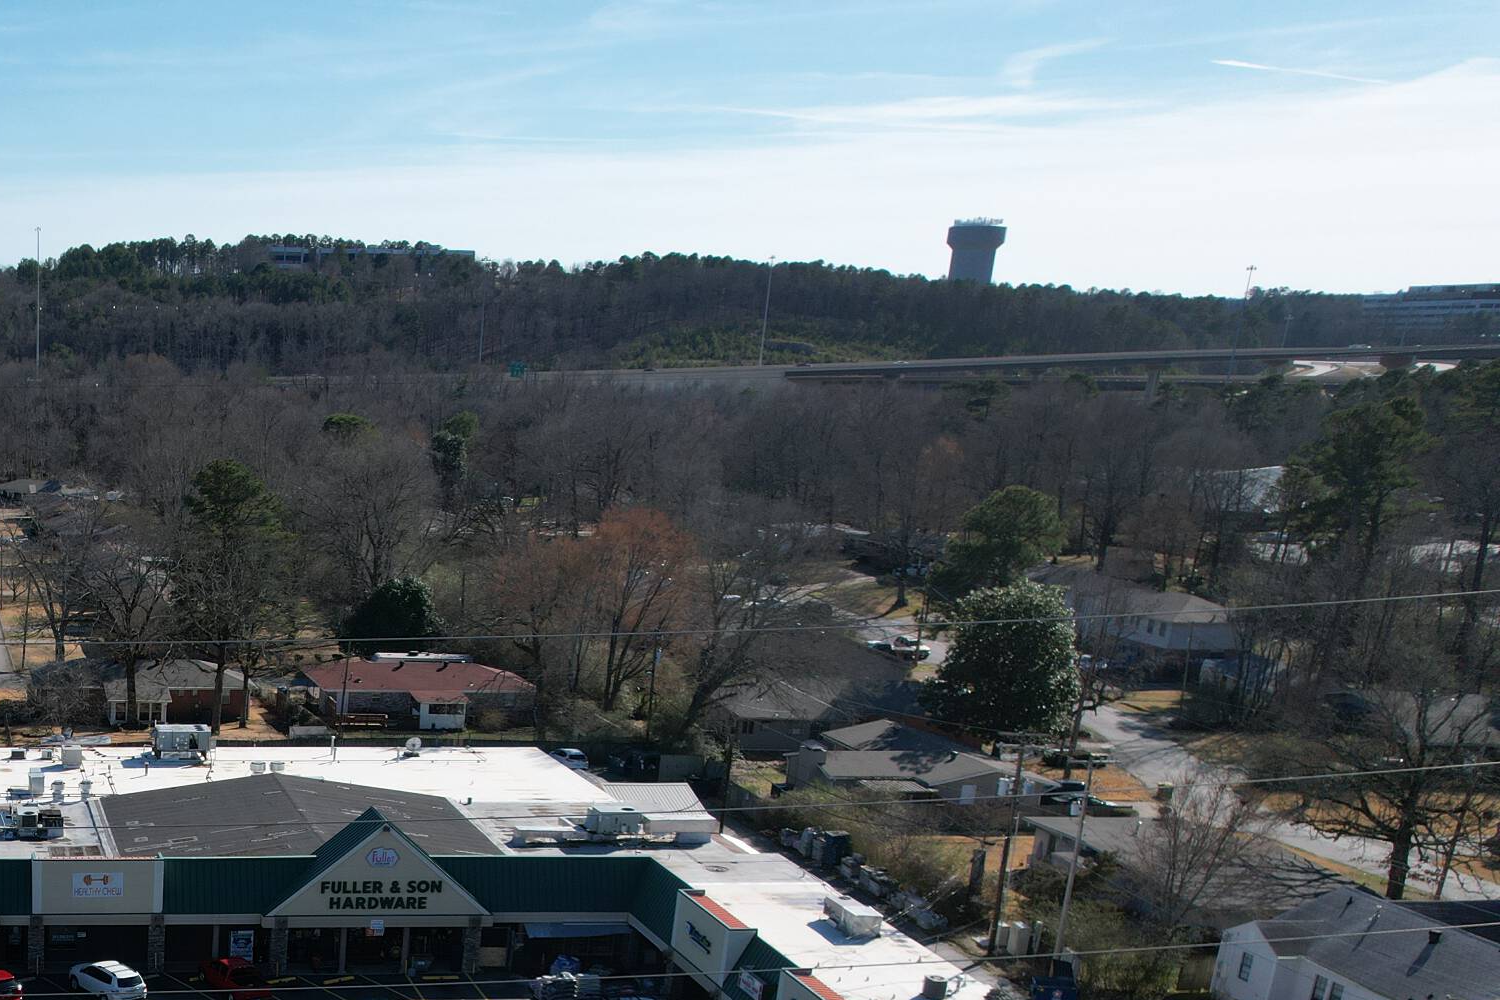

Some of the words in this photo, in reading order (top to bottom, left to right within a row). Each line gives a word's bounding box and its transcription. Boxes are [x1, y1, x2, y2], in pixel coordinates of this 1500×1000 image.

[320, 880, 383, 894] FULLER
[389, 880, 401, 893] &
[406, 880, 443, 893] SON
[328, 896, 428, 910] HARDWARE
